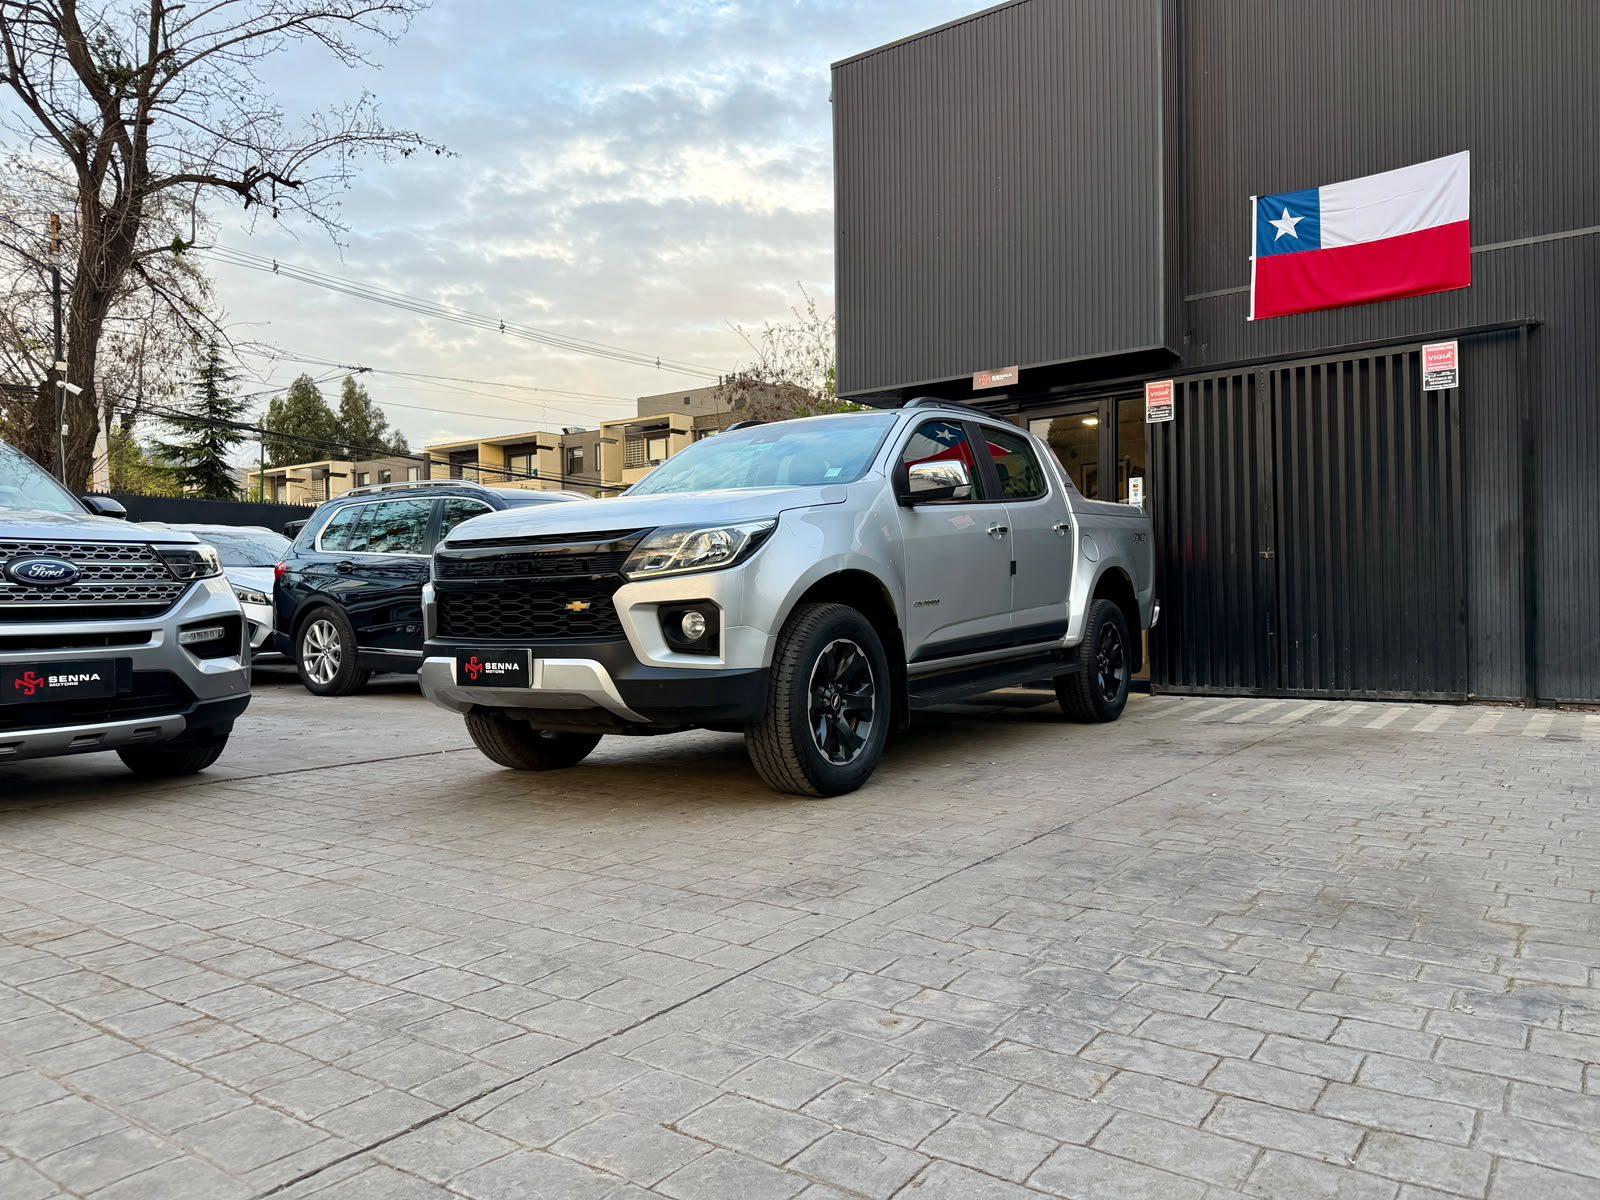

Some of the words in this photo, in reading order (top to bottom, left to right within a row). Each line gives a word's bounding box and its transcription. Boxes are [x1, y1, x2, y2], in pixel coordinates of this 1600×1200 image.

[28, 563, 65, 578] Ford
[485, 662, 520, 671] SENNA
[48, 673, 101, 683] SENNA
